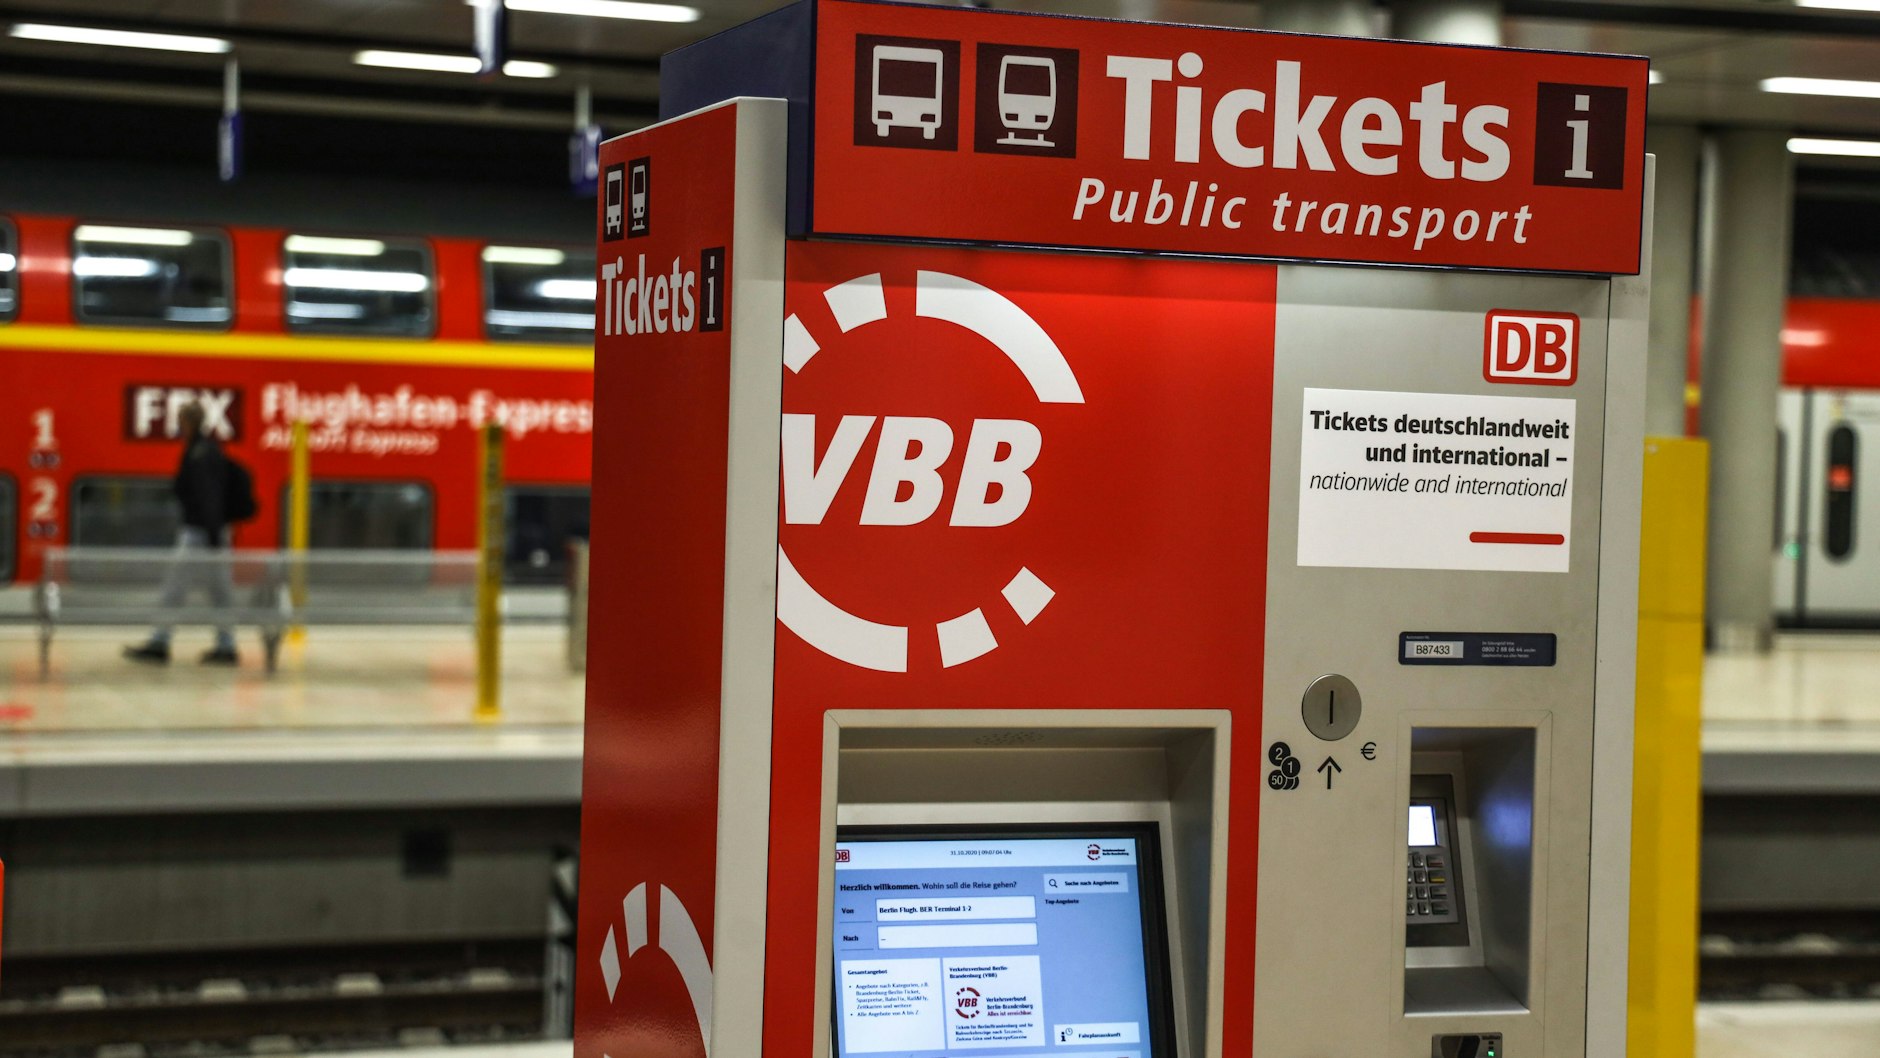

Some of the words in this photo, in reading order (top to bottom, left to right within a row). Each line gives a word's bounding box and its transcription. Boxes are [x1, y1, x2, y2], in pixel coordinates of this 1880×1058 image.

[1106, 52, 1511, 183] Tickets
[1072, 176, 1247, 230] Public
[1272, 190, 1533, 251] transport
[601, 253, 695, 337] Tickets
[1495, 321, 1568, 374] DB
[31, 408, 56, 448] 1
[1310, 410, 1388, 433] Tickets
[1394, 414, 1570, 440] deutschlandweit
[1365, 443, 1406, 464] und
[1412, 443, 1550, 468] international
[781, 413, 1042, 528] VBB
[1309, 471, 1410, 493] nationwide
[1414, 474, 1451, 494] and
[1455, 475, 1568, 498] international
[30, 477, 58, 520] 2
[1416, 644, 1450, 655] B87433
[1275, 747, 1283, 761] 2
[1287, 761, 1293, 774] 1
[1271, 775, 1283, 785] 50
[874, 883, 920, 891] willkommen.
[992, 881, 1017, 890] gehen?
[958, 998, 978, 1008] VBB
